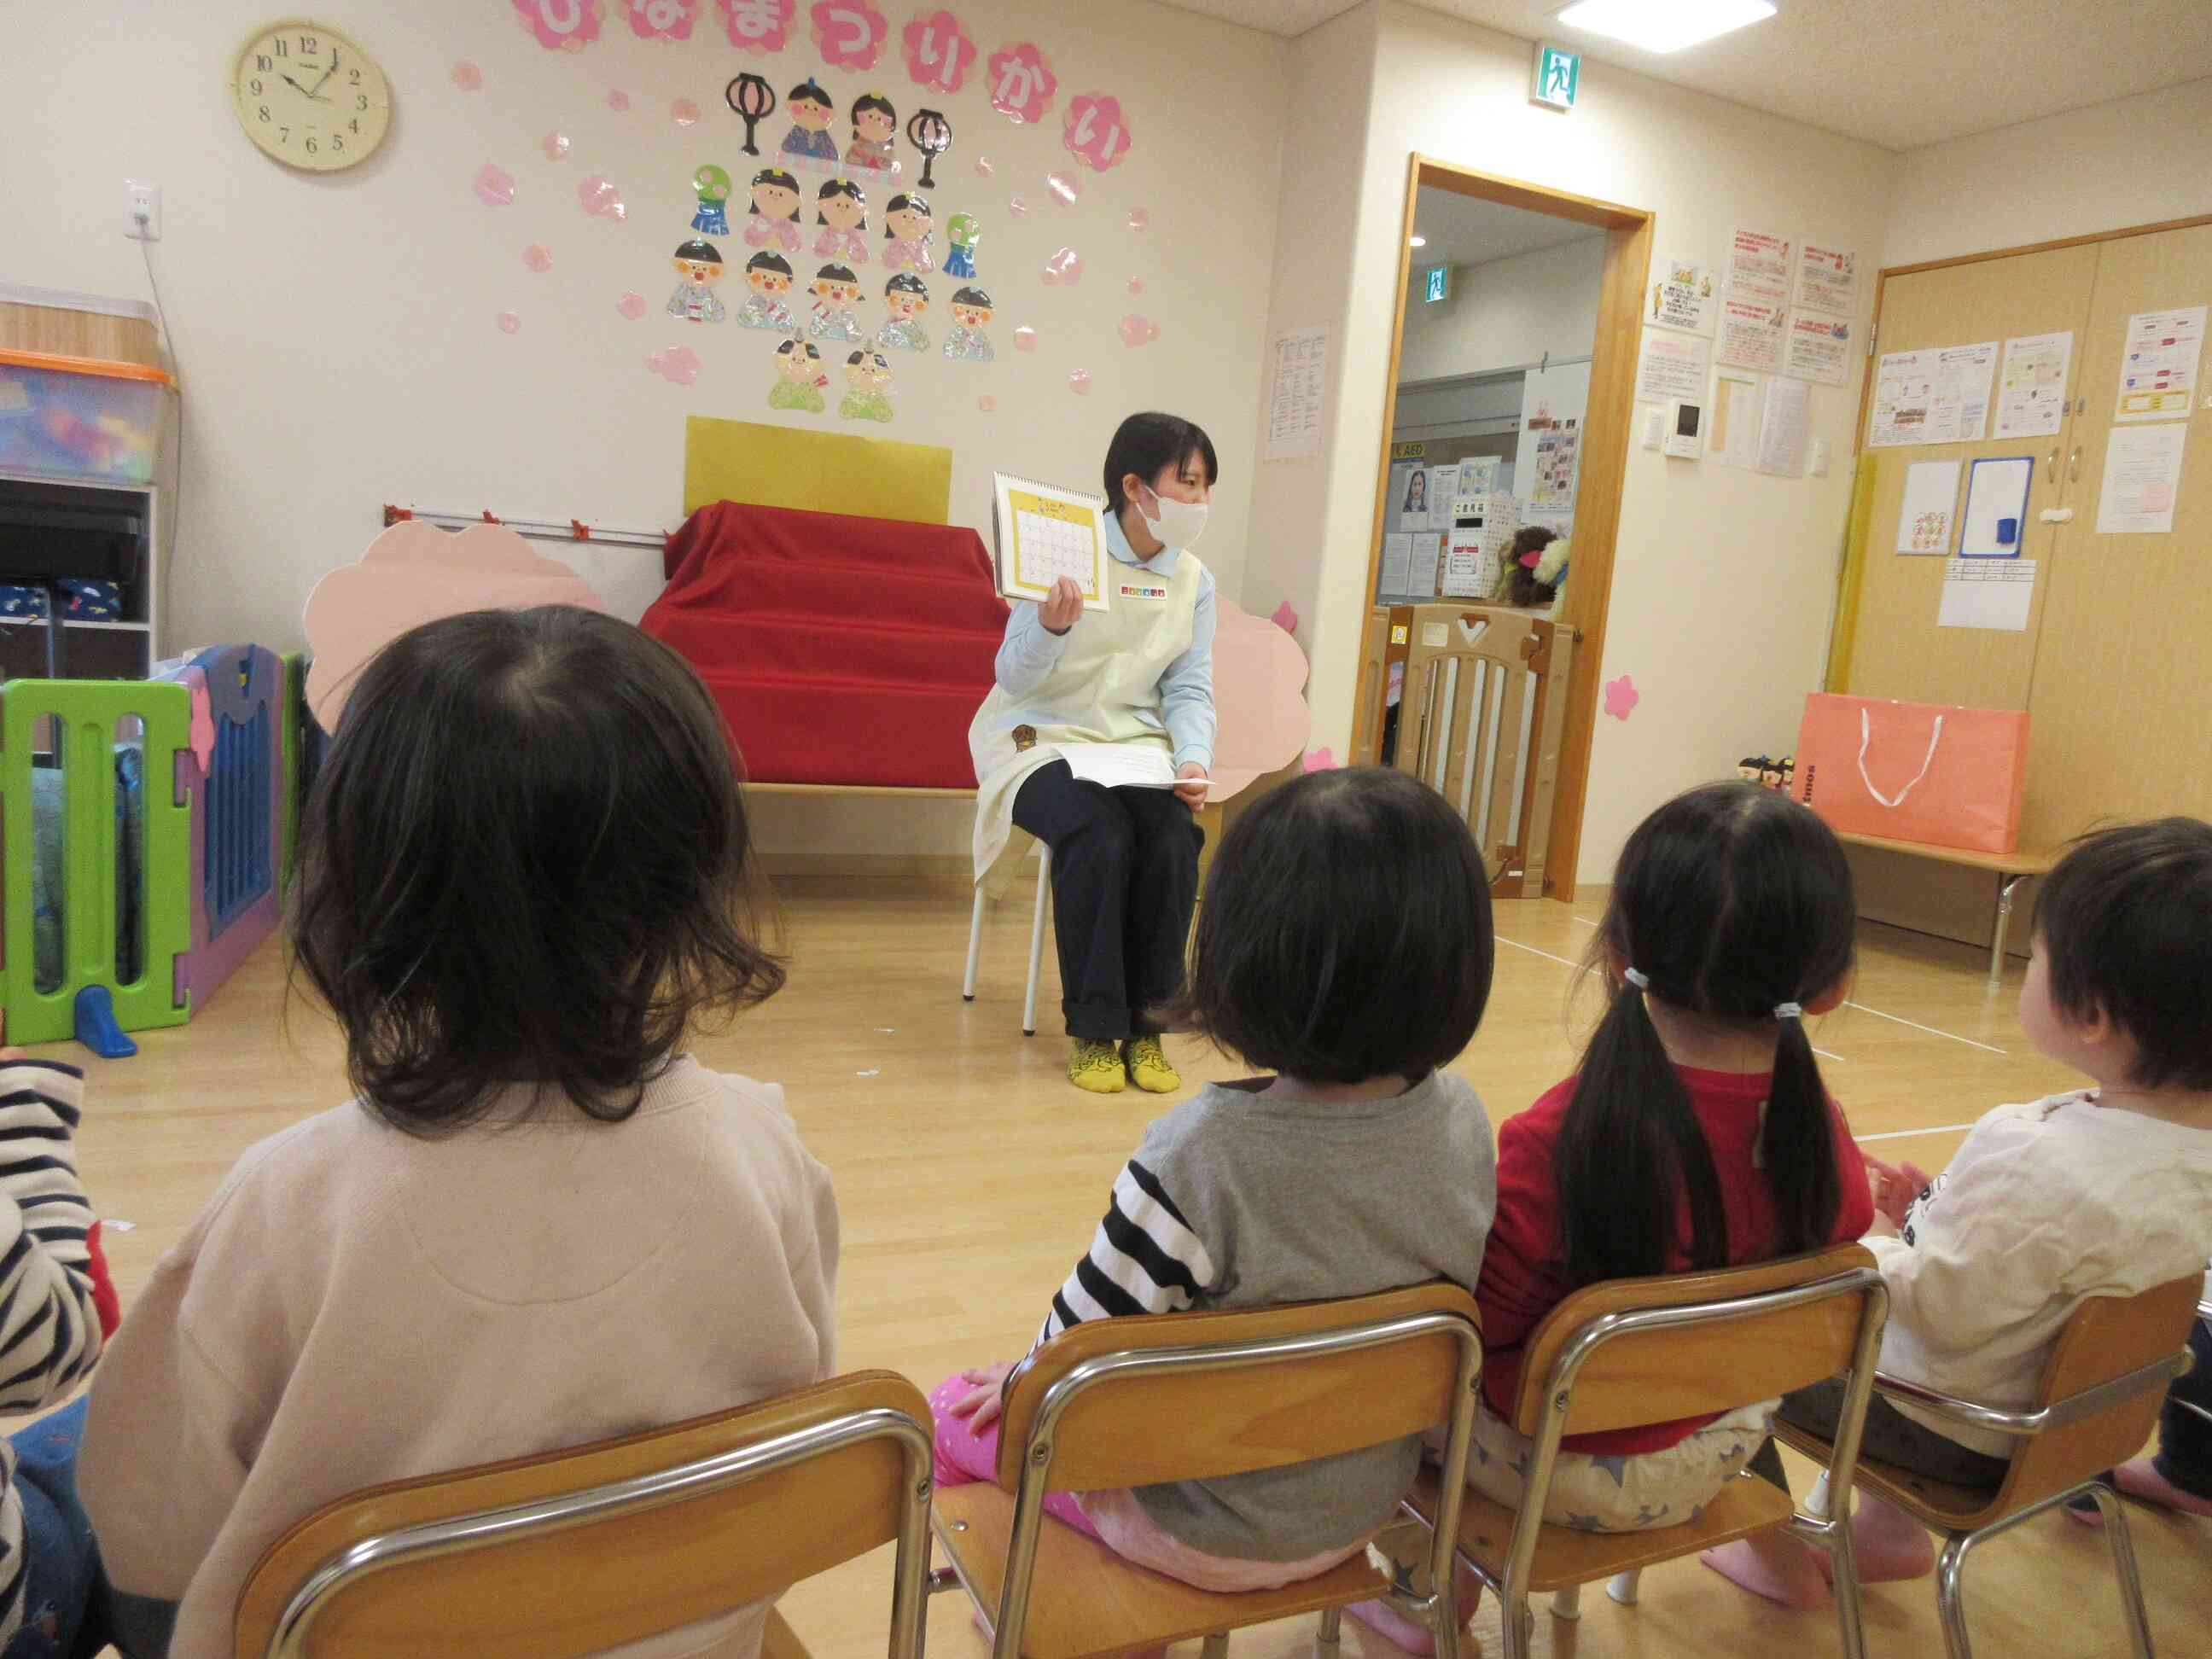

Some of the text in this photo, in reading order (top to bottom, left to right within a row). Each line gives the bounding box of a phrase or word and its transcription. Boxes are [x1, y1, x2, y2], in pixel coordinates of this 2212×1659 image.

[275, 39, 288, 57] 11
[300, 37, 317, 55] 12
[257, 55, 273, 73] 10
[348, 69, 361, 86] 2
[250, 79, 263, 96] 9
[356, 95, 368, 111] 3
[259, 105, 271, 123] 8
[279, 127, 289, 143] 7
[347, 119, 360, 134] 4
[306, 137, 317, 154] 6
[332, 135, 343, 151] 5
[1403, 443, 1423, 456] AED
